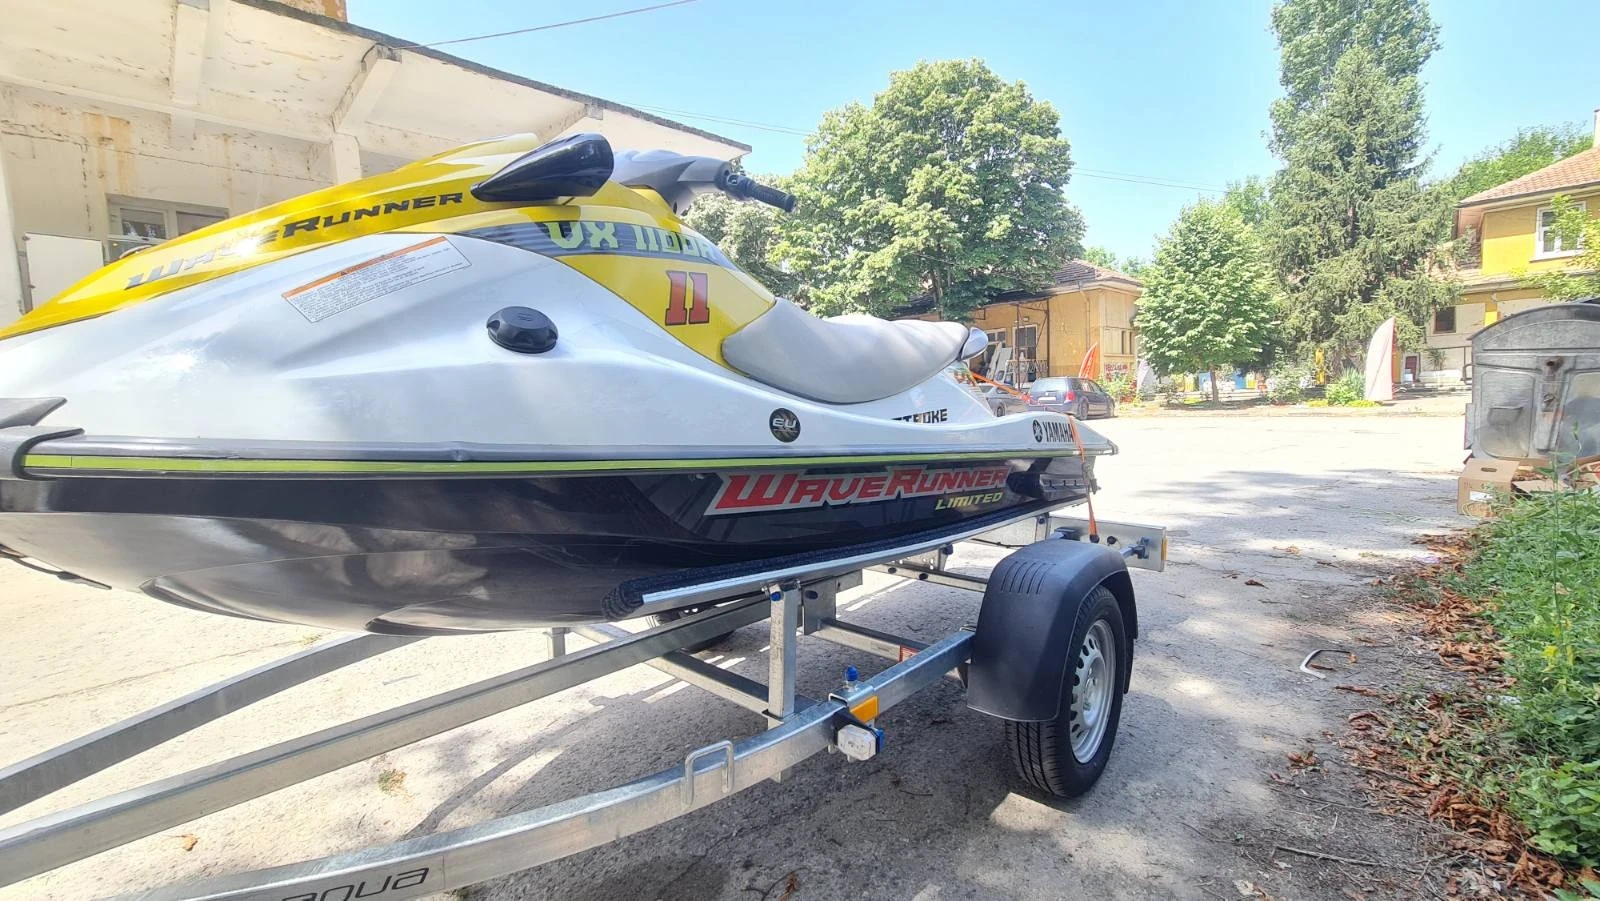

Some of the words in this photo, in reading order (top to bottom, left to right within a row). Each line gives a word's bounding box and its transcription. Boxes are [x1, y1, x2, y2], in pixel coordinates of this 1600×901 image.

[546, 222, 619, 248] VX
[665, 270, 710, 326] 11
[772, 418, 797, 429] EU
[892, 408, 948, 424] TROKE
[700, 465, 1010, 511] WAVERUNNER
[934, 492, 1004, 511] LIMITED
